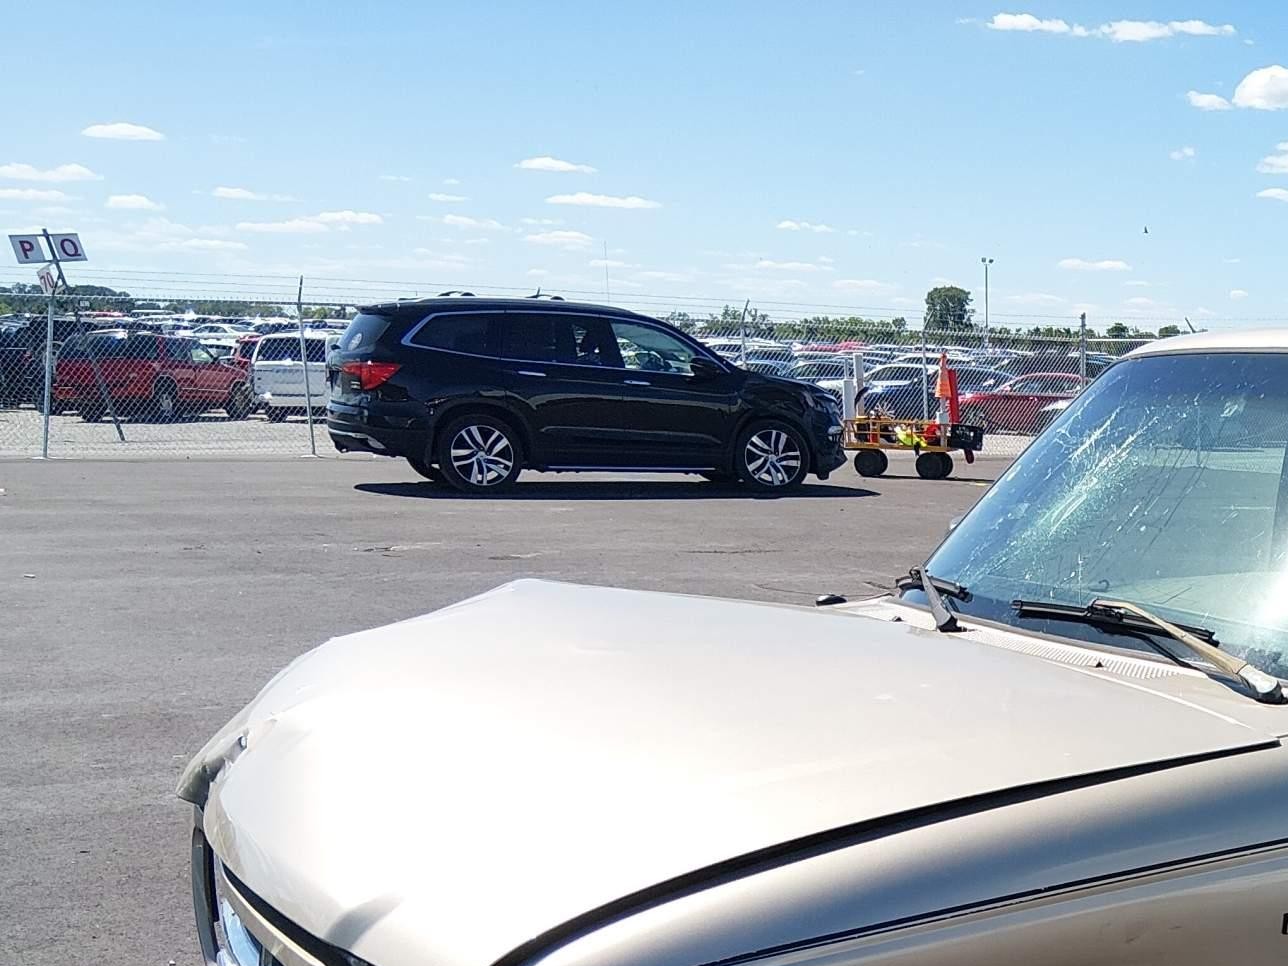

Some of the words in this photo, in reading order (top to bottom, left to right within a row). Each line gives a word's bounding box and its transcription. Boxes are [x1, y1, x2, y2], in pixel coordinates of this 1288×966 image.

[19, 240, 34, 259] P
[60, 238, 82, 258] Q
[39, 271, 55, 291] 70
